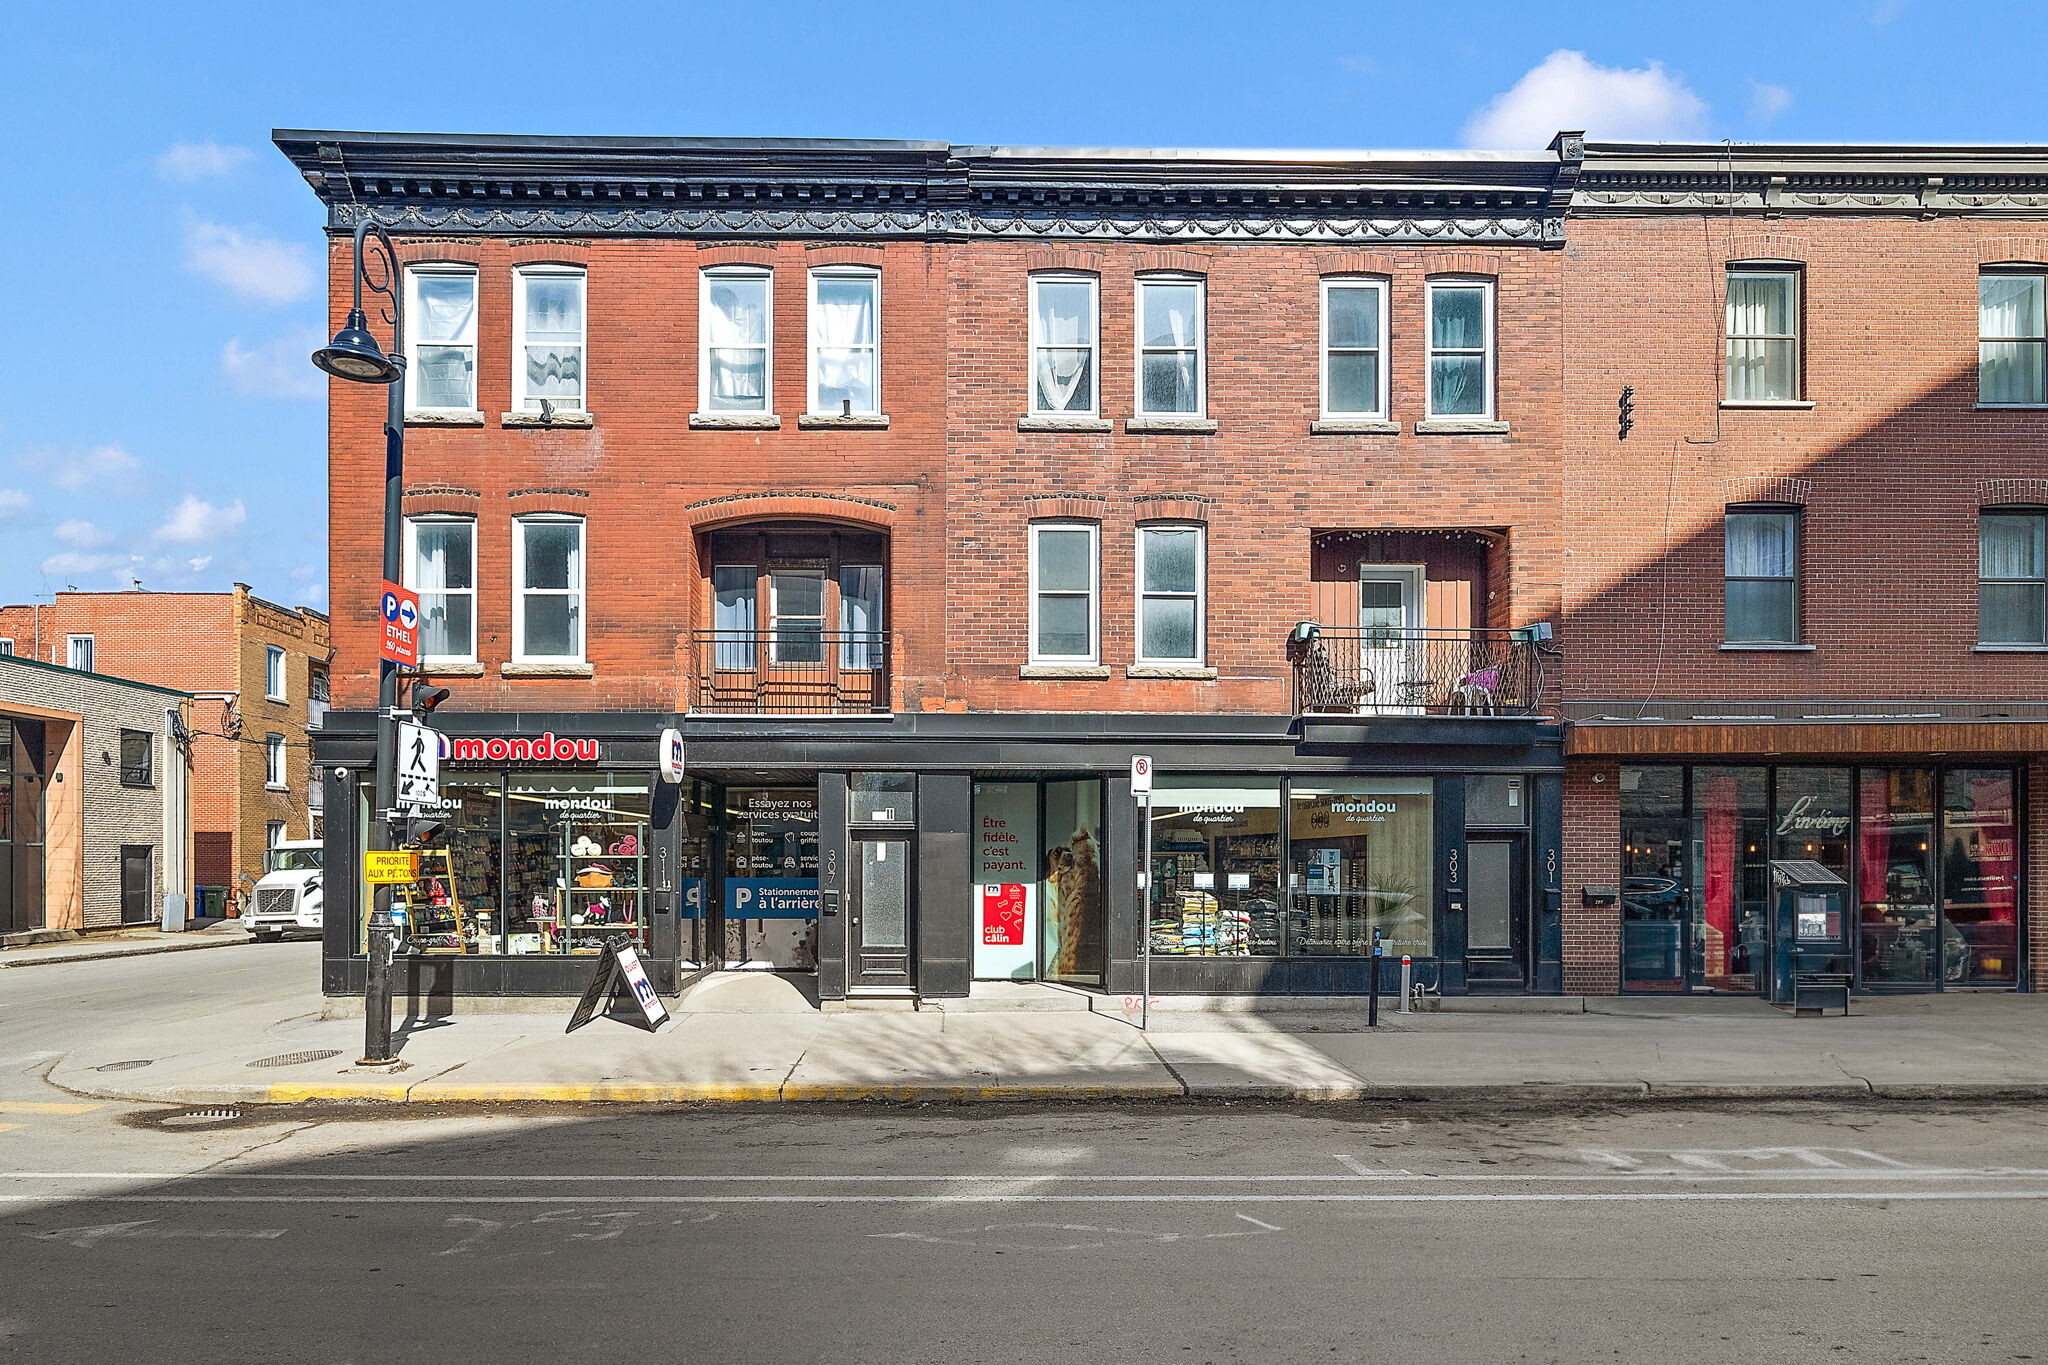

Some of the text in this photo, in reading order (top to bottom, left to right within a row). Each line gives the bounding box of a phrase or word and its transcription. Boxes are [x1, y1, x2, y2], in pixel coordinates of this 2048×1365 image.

[386, 622, 412, 644] ÉTHEL
[453, 731, 600, 760] mondou
[545, 796, 611, 810] mondou
[748, 798, 812, 810] Essayez nos
[1178, 800, 1245, 813] mondou
[1331, 800, 1396, 812] mondou
[559, 810, 601, 820] de quartier
[737, 809, 780, 819] services
[1193, 813, 1203, 822] de
[1203, 813, 1235, 824] quartier
[1345, 813, 1387, 824] de quartier
[983, 815, 1006, 828] Être
[983, 831, 1019, 844] fidèle,
[983, 846, 1009, 857] c'est
[751, 855, 770, 864] pèse-
[1449, 848, 1458, 883] 303
[1547, 848, 1556, 883] 301
[828, 849, 836, 884] 307
[983, 860, 1027, 873] payant.
[368, 868, 385, 878] AUX
[736, 887, 752, 909] P
[758, 897, 767, 909] à
[984, 924, 1006, 934] club
[984, 934, 1010, 943] câlin
